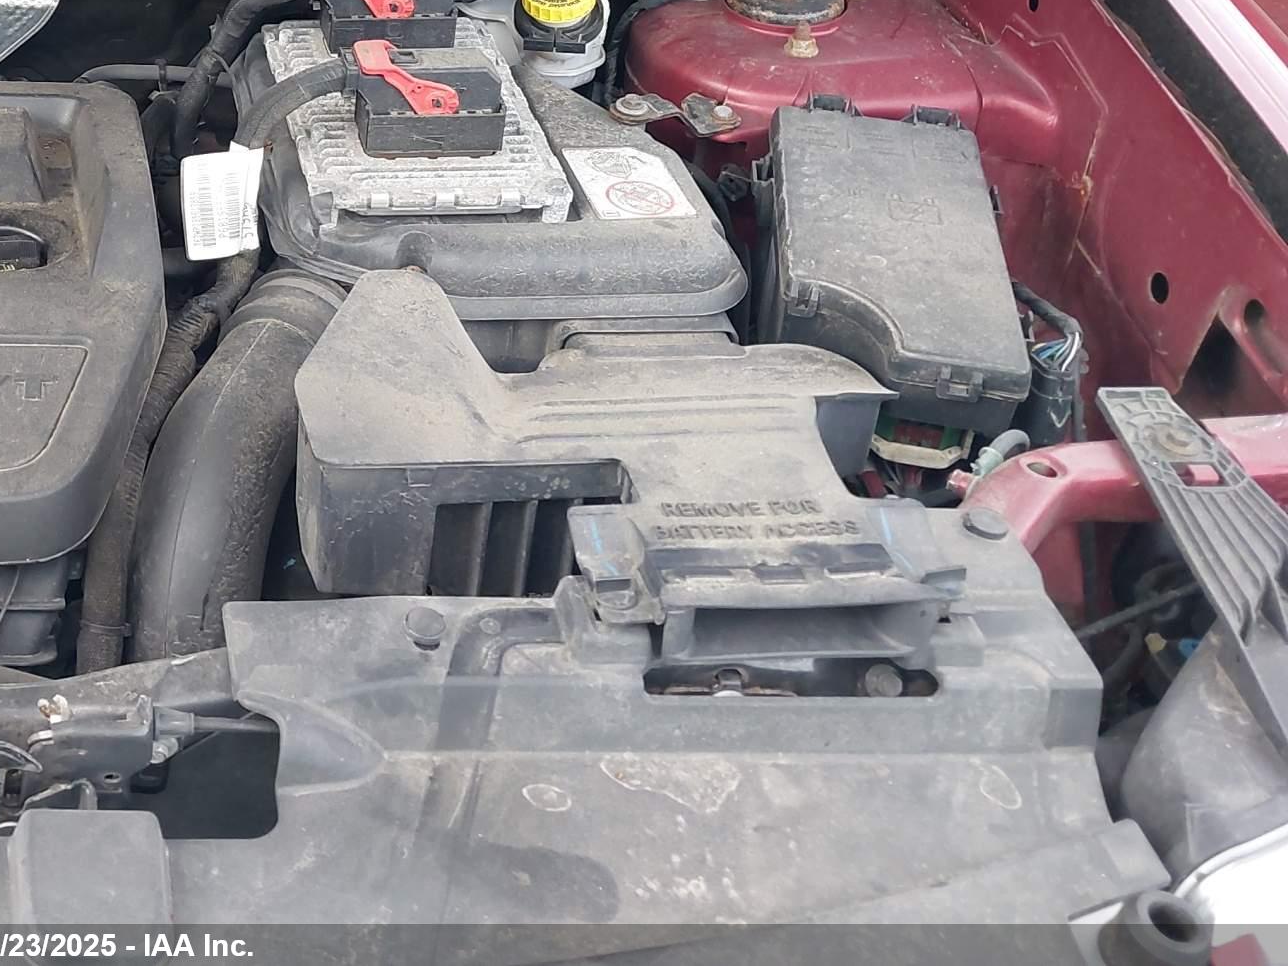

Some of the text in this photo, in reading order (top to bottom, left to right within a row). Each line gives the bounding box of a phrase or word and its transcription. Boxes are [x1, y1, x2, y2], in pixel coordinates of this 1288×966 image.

[660, 499, 822, 517] REMOVE FOR
[655, 520, 860, 541] BATTERY ACCESS
